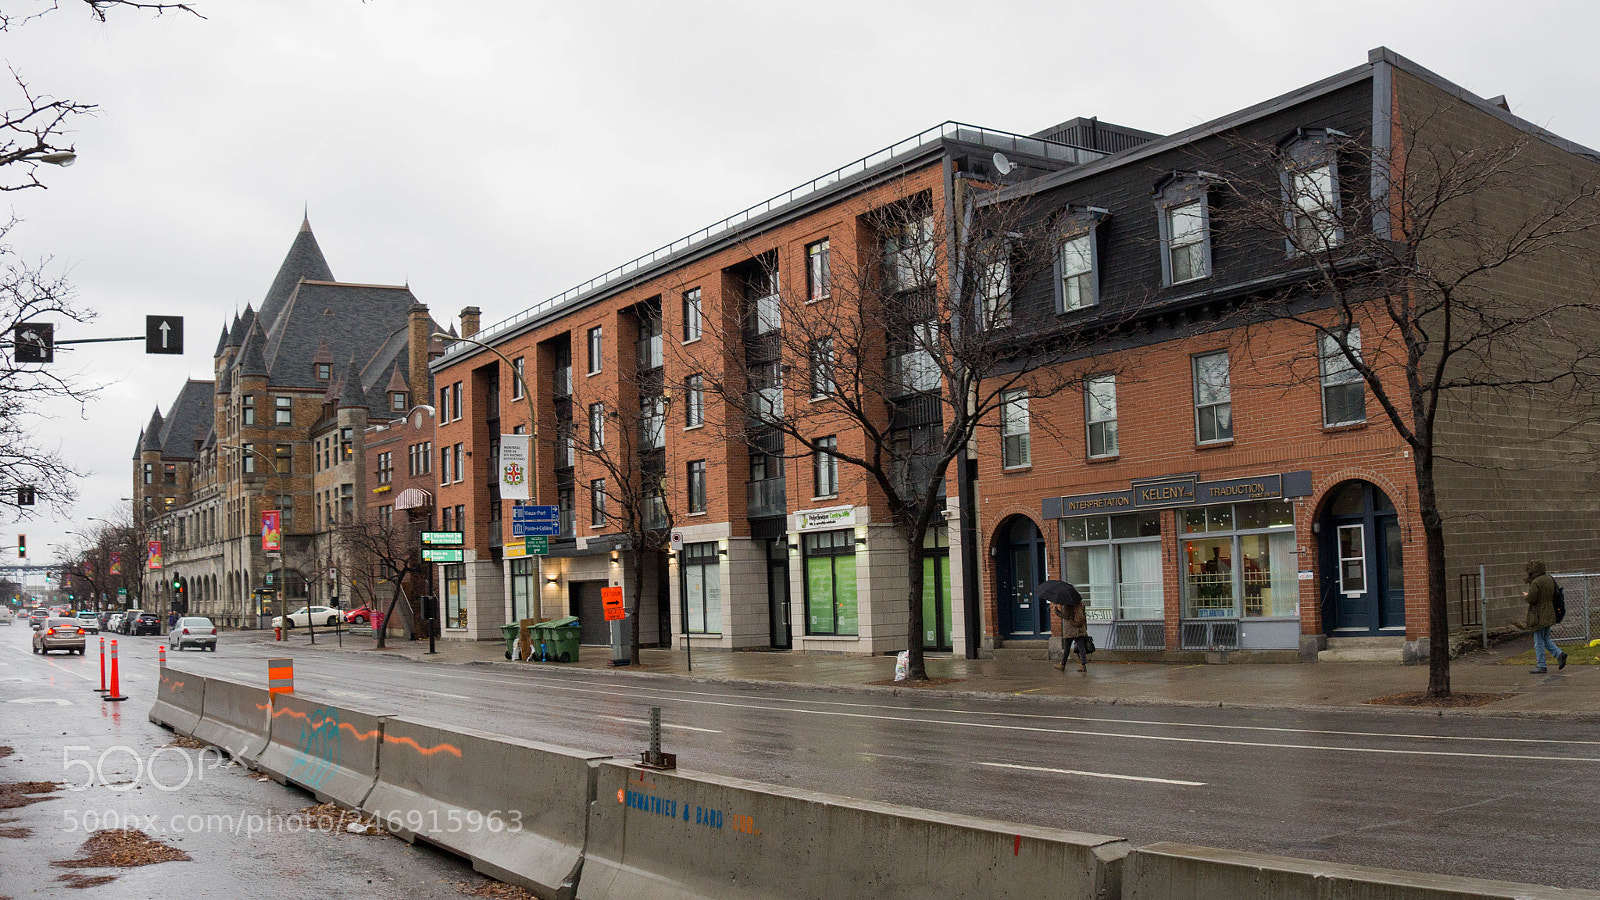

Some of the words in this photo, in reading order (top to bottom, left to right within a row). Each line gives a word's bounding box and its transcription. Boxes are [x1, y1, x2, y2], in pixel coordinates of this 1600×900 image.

[1142, 486, 1185, 501] KELENY
[1209, 483, 1265, 497] TRADUCTION
[626, 790, 677, 818] DEMATHIEU
[682, 803, 690, 822] &
[696, 806, 724, 829] BARD
